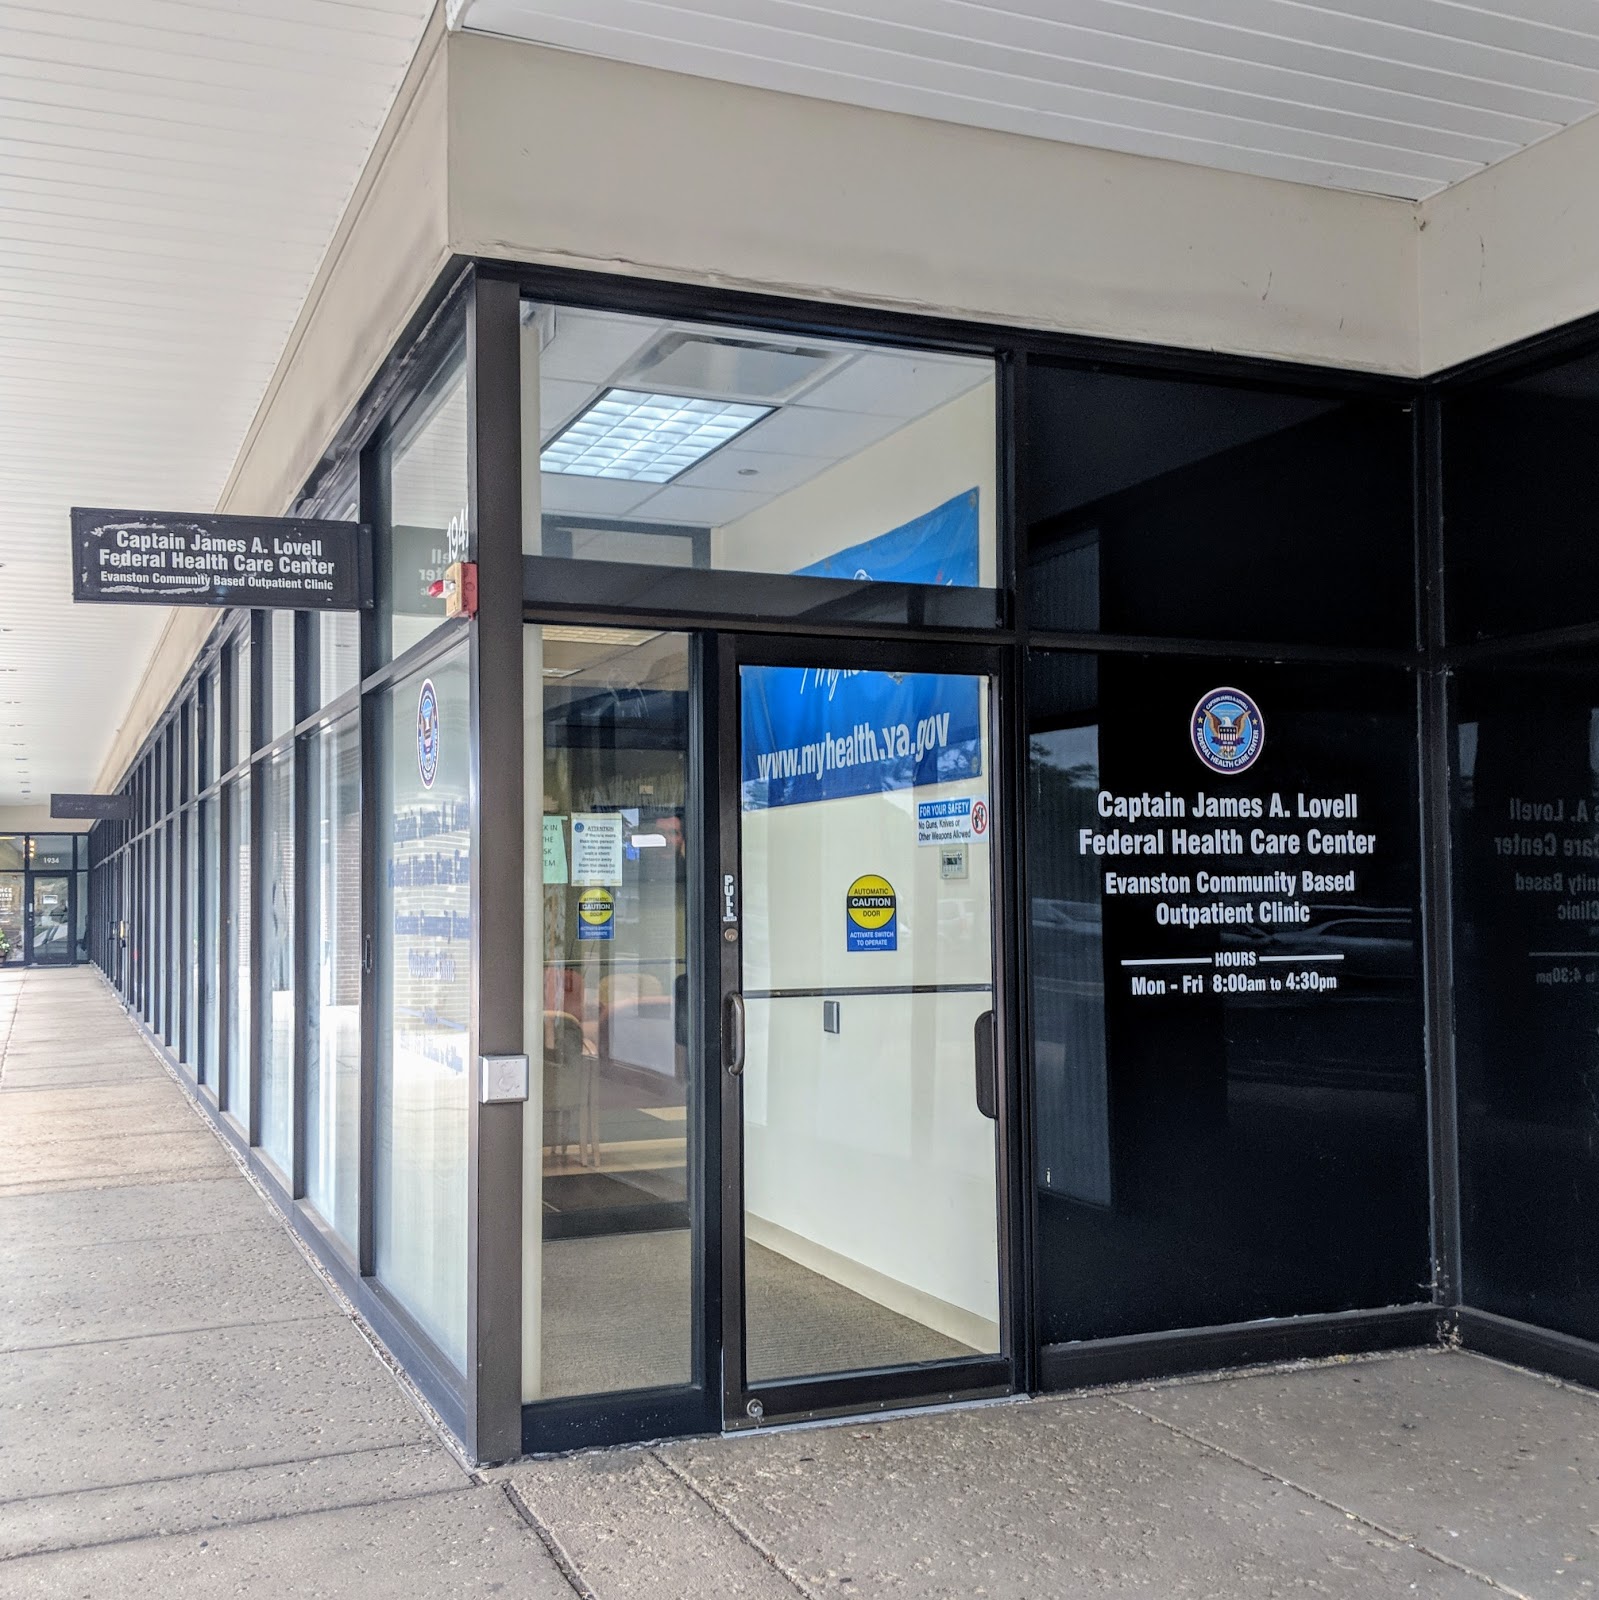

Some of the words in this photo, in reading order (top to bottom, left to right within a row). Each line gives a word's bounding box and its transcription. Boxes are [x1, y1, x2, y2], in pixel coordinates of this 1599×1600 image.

[116, 531, 185, 552] Captain
[191, 534, 246, 553] James
[251, 537, 268, 554] A.
[274, 538, 321, 556] Lovell
[100, 549, 166, 568] Federal
[172, 552, 228, 570] Health
[234, 555, 274, 572] Care
[279, 556, 334, 575] Center
[101, 571, 149, 583] Evanston
[153, 573, 210, 586] Community
[214, 575, 244, 586] Based
[248, 577, 302, 589] Outpatient
[305, 579, 333, 590] Clinic
[757, 712, 950, 781] www.myhealth.va.gov
[1197, 728, 1211, 758] FEDERAL
[1210, 756, 1234, 767] HEALTH
[1234, 754, 1249, 767] CARE
[1248, 730, 1258, 755] CENTER
[920, 808, 930, 817] FOR
[931, 805, 946, 816] YOUR
[948, 802, 969, 814] SAFETY
[1098, 791, 1185, 823] Captain
[1192, 792, 1263, 818] James
[1269, 793, 1290, 818] A.
[1298, 793, 1357, 818] Lovell
[919, 832, 931, 841] Other
[932, 831, 952, 841] Weapons
[953, 830, 971, 838] Allowed
[940, 819, 954, 828] Knives
[1080, 829, 1164, 855] Federal
[1172, 829, 1243, 854] Health
[1250, 829, 1300, 854] Care
[1307, 829, 1376, 854] Center
[724, 875, 734, 917] PULL
[1106, 872, 1190, 894] Evanston
[1197, 871, 1296, 896] Community
[1302, 871, 1355, 892] Based
[852, 898, 891, 906] CAUTION
[1157, 902, 1254, 929] Outpatient
[1260, 901, 1310, 923] Clinic
[1215, 951, 1256, 967] HOURS
[1132, 976, 1166, 995] Mon
[1183, 975, 1203, 993] Fri
[1213, 974, 1266, 992] 8:00am
[1270, 978, 1282, 990] to
[1286, 972, 1337, 992] 4:30pm
